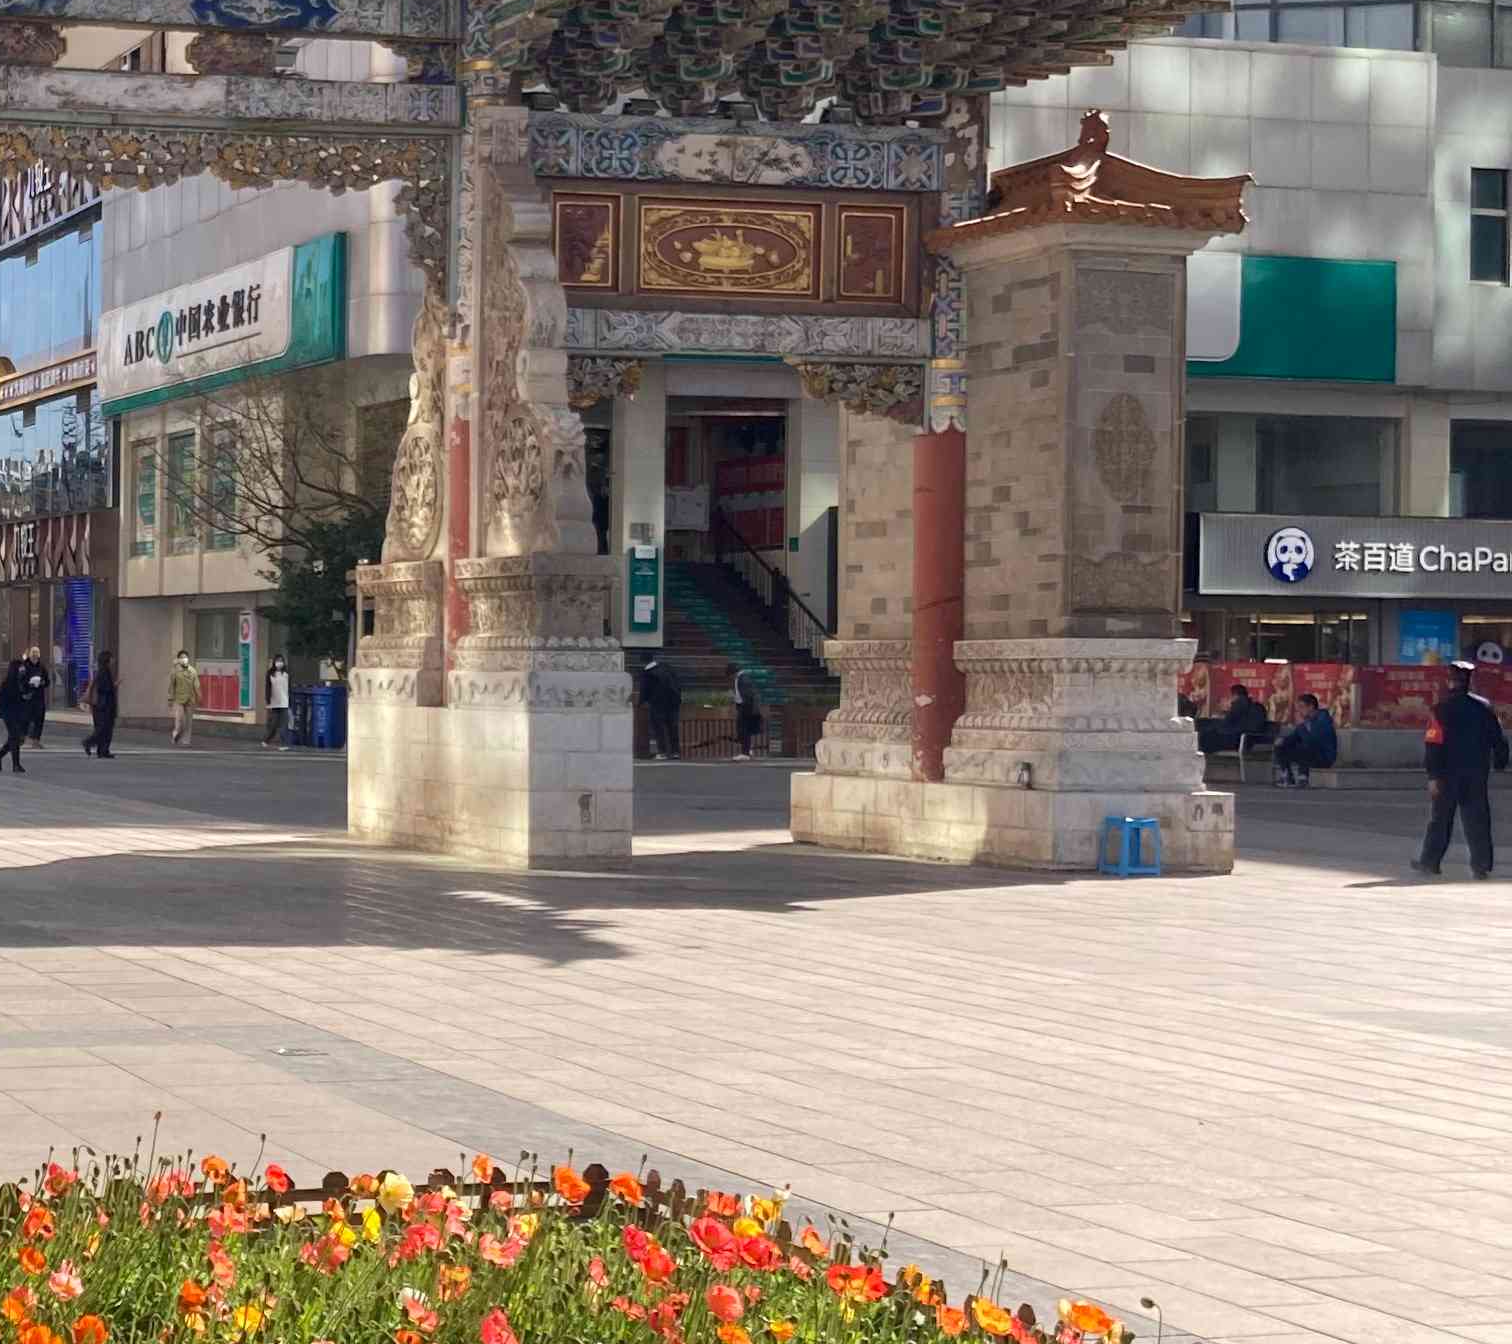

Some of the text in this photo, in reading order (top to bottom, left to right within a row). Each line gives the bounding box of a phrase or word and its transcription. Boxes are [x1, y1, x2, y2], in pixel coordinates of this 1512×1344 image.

[124, 283, 262, 366] ABC 中国农业银行
[1334, 541, 1416, 573] 茶百道
